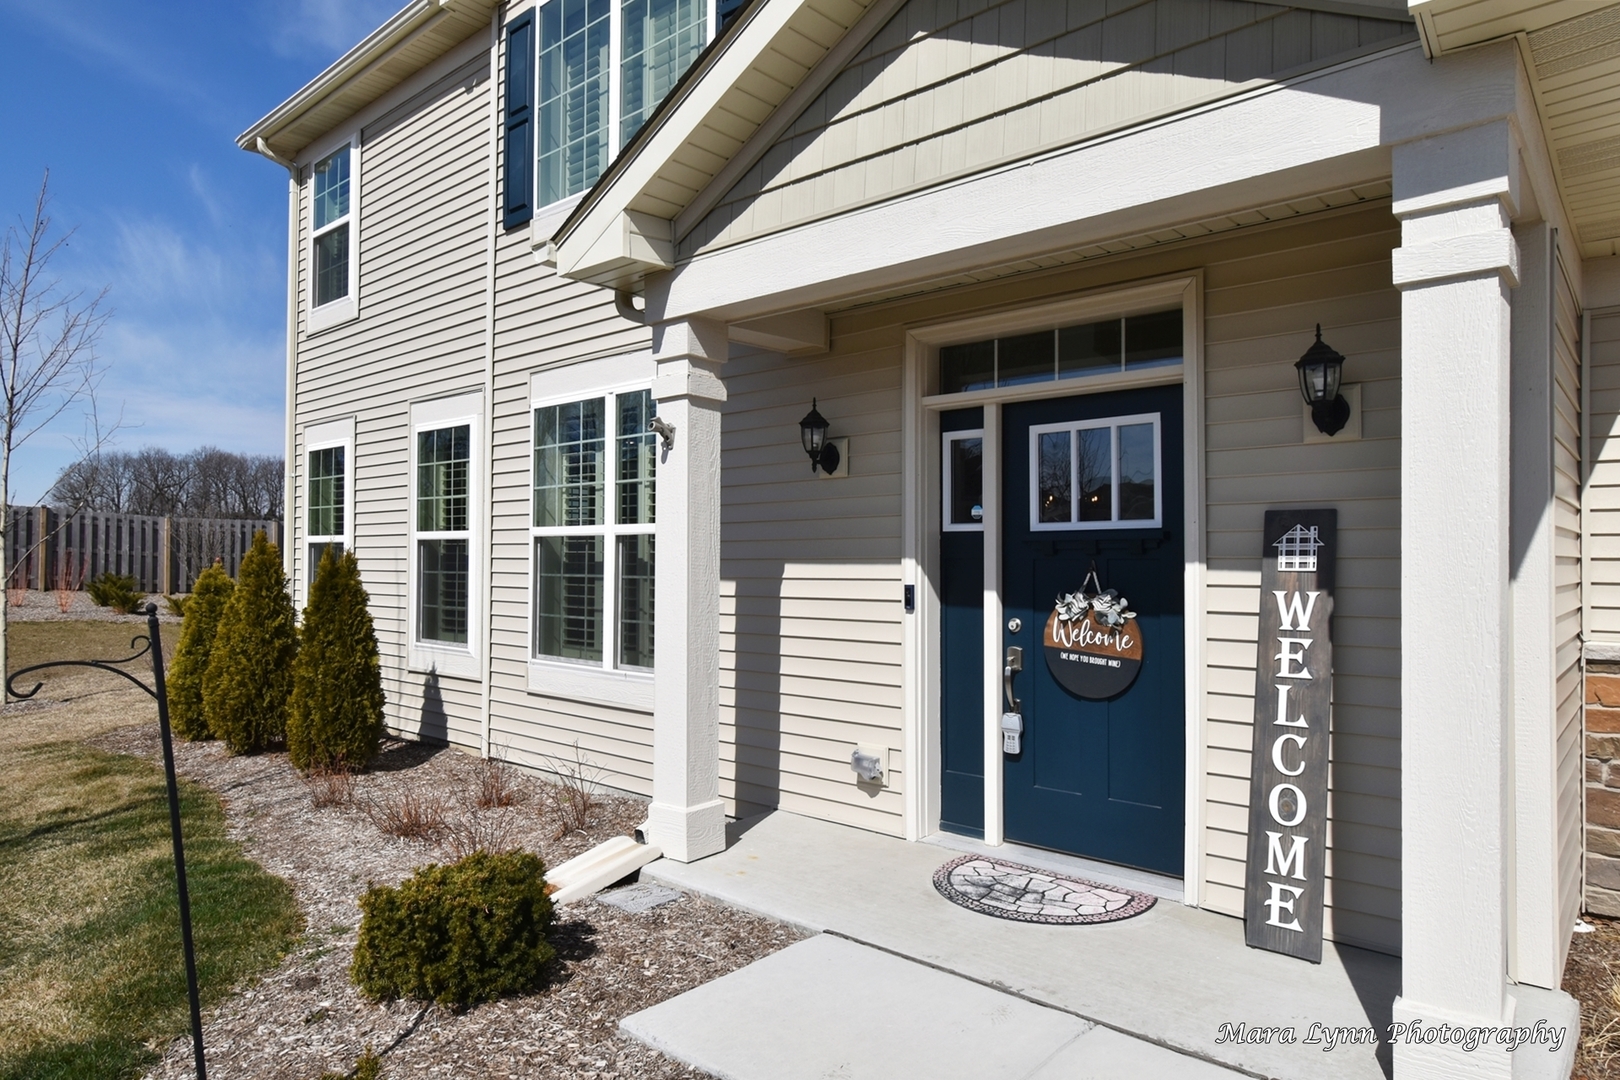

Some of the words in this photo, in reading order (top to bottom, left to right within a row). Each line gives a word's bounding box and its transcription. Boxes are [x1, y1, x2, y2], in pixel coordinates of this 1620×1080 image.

[1052, 616, 1134, 651] Welcome
[1069, 653, 1079, 662] HOPE
[1080, 655, 1089, 663] YOU
[1089, 656, 1107, 666] BROUGHT
[1263, 590, 1321, 932] WELCOME
